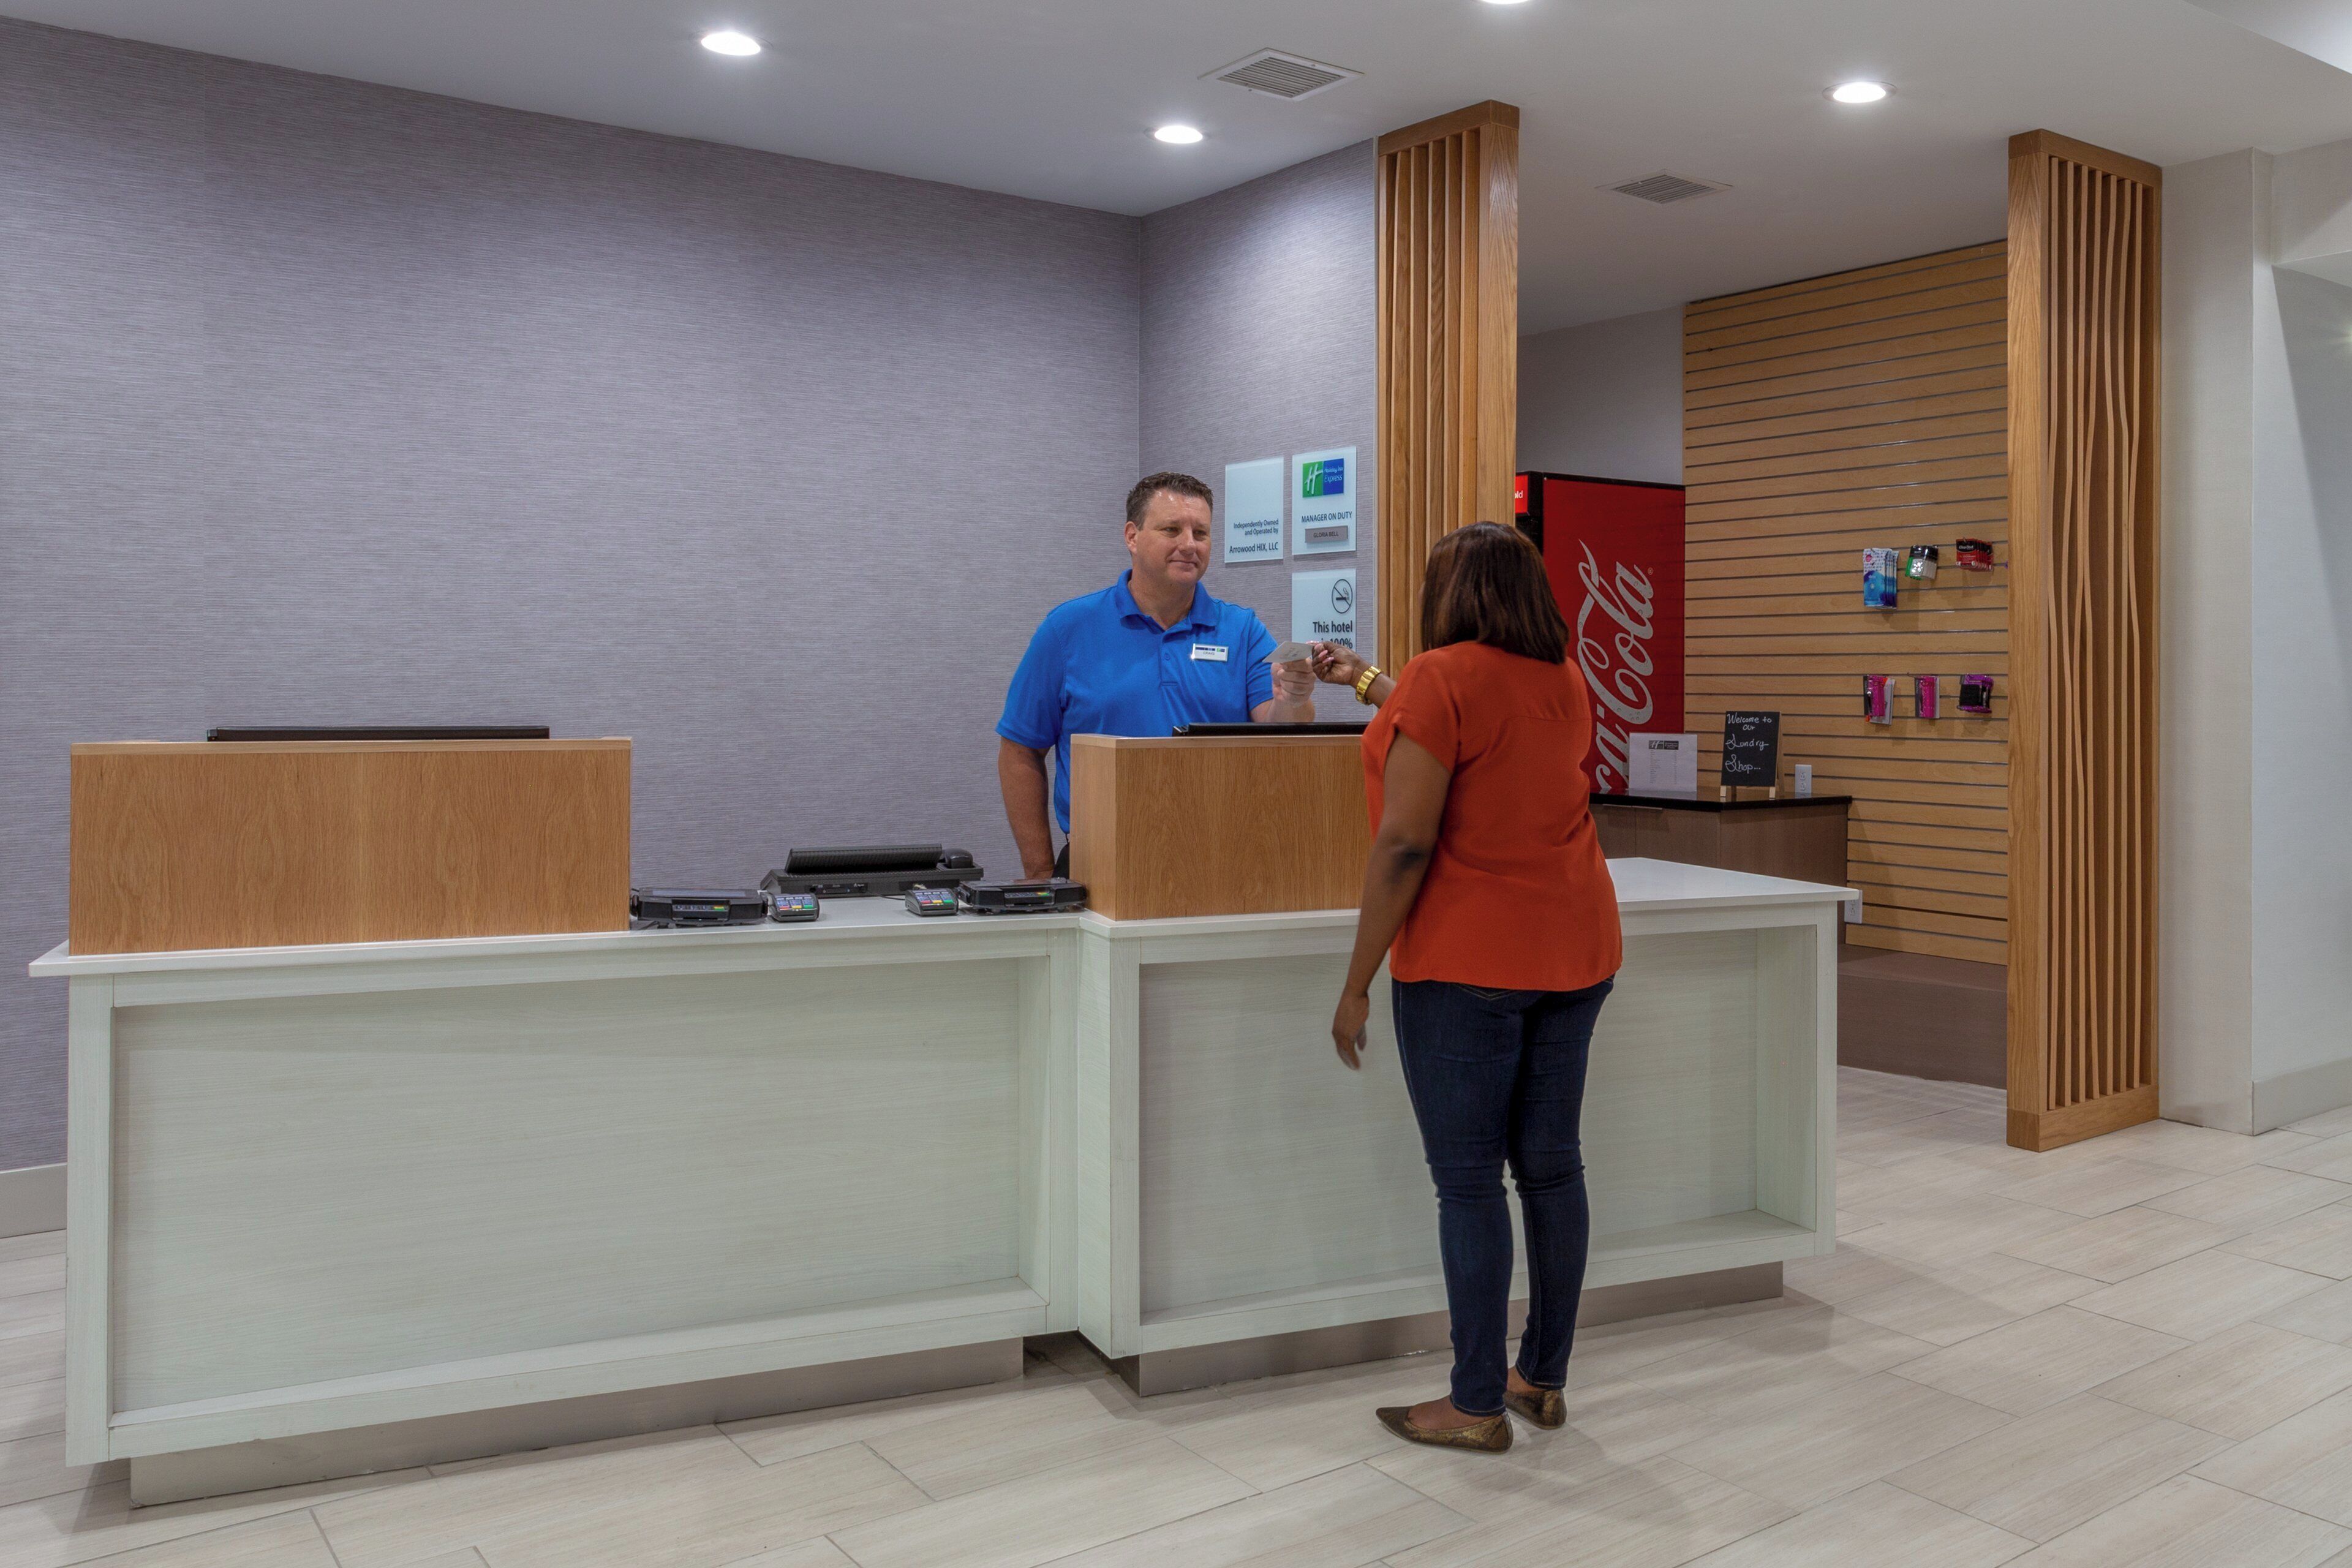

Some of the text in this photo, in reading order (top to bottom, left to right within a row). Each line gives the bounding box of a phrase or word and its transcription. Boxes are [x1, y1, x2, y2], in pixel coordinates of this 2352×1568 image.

[1302, 513, 1327, 522] MANAGER
[1234, 520, 1262, 529] Independently
[1253, 527, 1272, 536] Operated
[1229, 541, 1278, 553] Arrowood HIX, LLC
[1313, 620, 1352, 633] This hotel
[1727, 712, 1759, 724] Welcome
